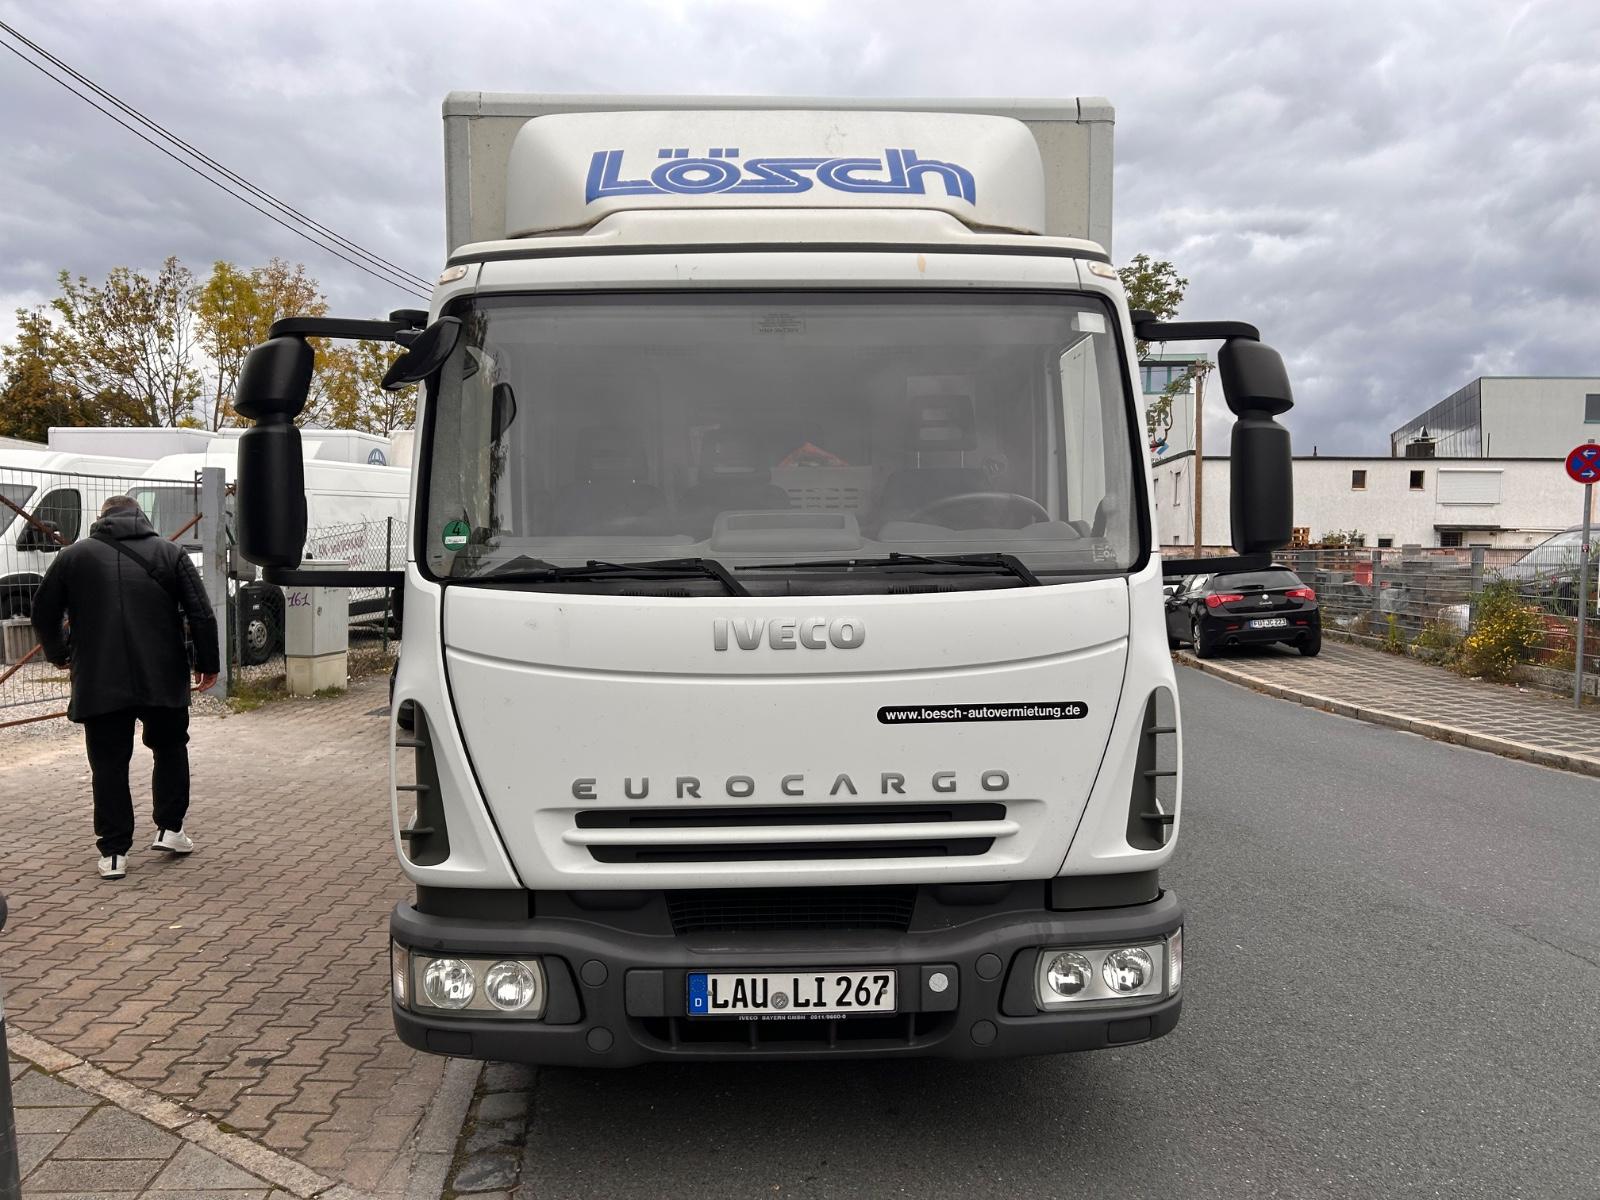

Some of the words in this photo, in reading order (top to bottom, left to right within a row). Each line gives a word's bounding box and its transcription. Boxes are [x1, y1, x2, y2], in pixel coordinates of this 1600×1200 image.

[585, 147, 977, 207] Lösch
[452, 521, 462, 536] 4
[287, 592, 311, 607] 161
[713, 617, 866, 651] IVECO
[885, 704, 1081, 721] www.loesch-autovermietung.de
[571, 769, 1010, 800] EUROCARGO
[694, 998, 702, 1007] D
[711, 977, 769, 1009] LAU
[793, 977, 827, 1008] LI
[835, 975, 890, 1007] 267
